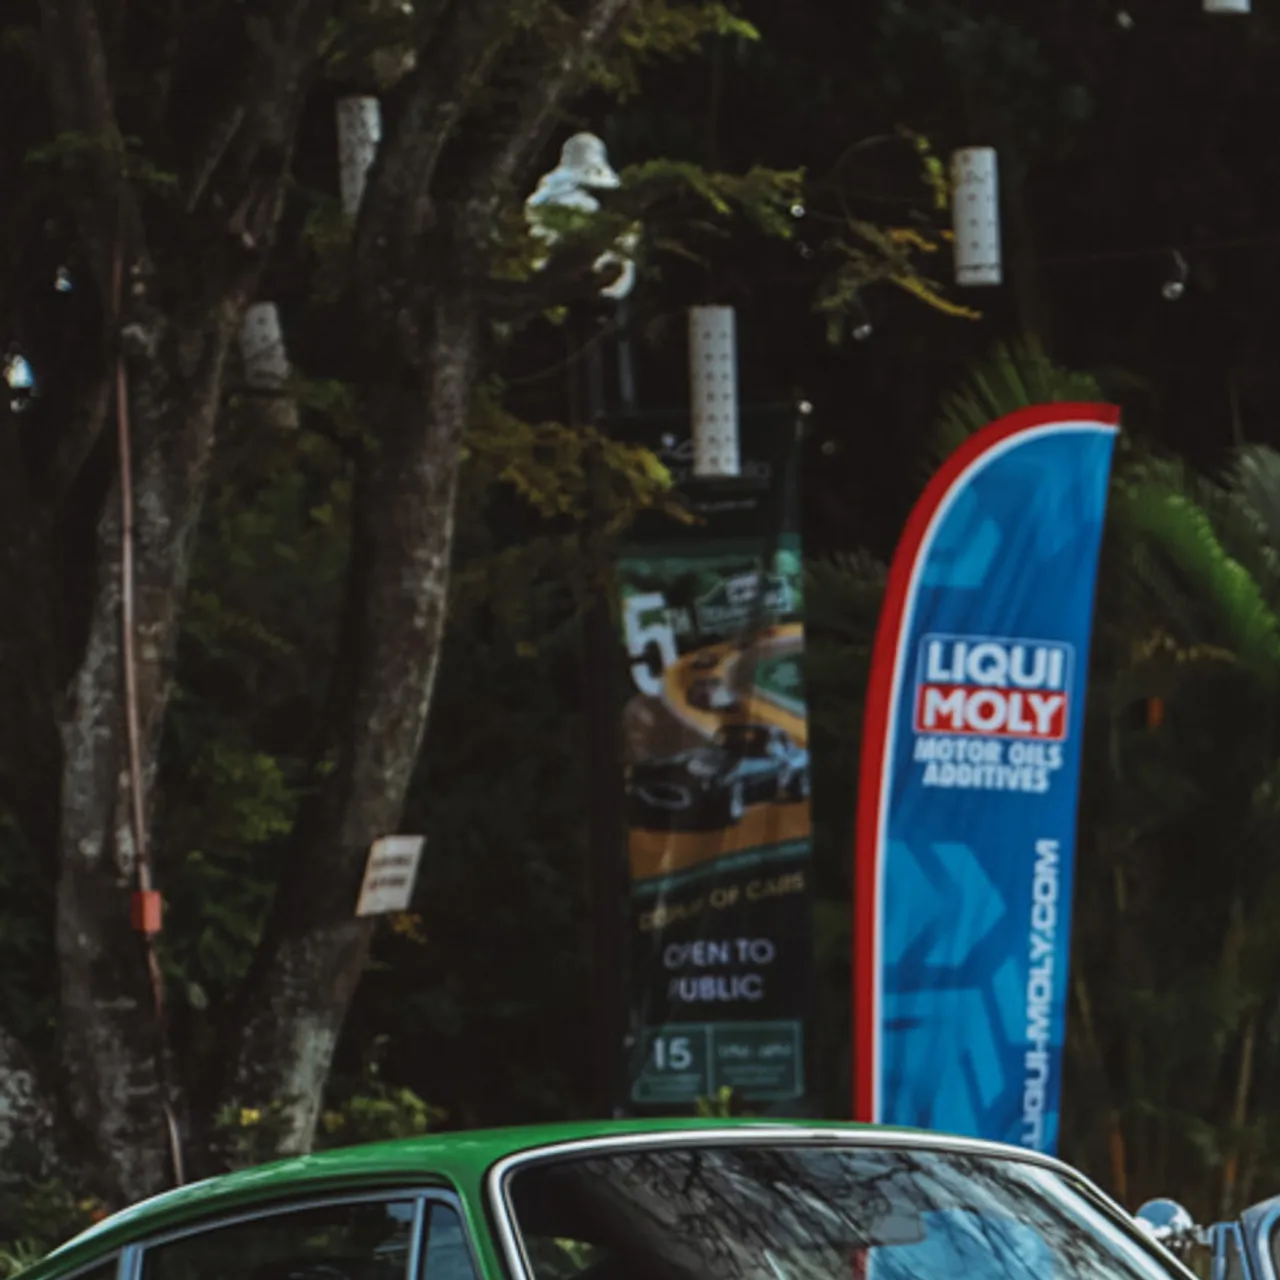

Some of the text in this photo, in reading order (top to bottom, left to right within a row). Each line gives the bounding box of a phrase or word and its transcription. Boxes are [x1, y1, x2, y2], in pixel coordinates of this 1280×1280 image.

[927, 640, 1064, 690] LIQUI
[923, 687, 1064, 734] MOLY
[914, 736, 1063, 770] MOTOR OILS
[922, 760, 1049, 794] ADDITIVES
[735, 937, 775, 964] TO
[653, 1036, 693, 1070] 15
